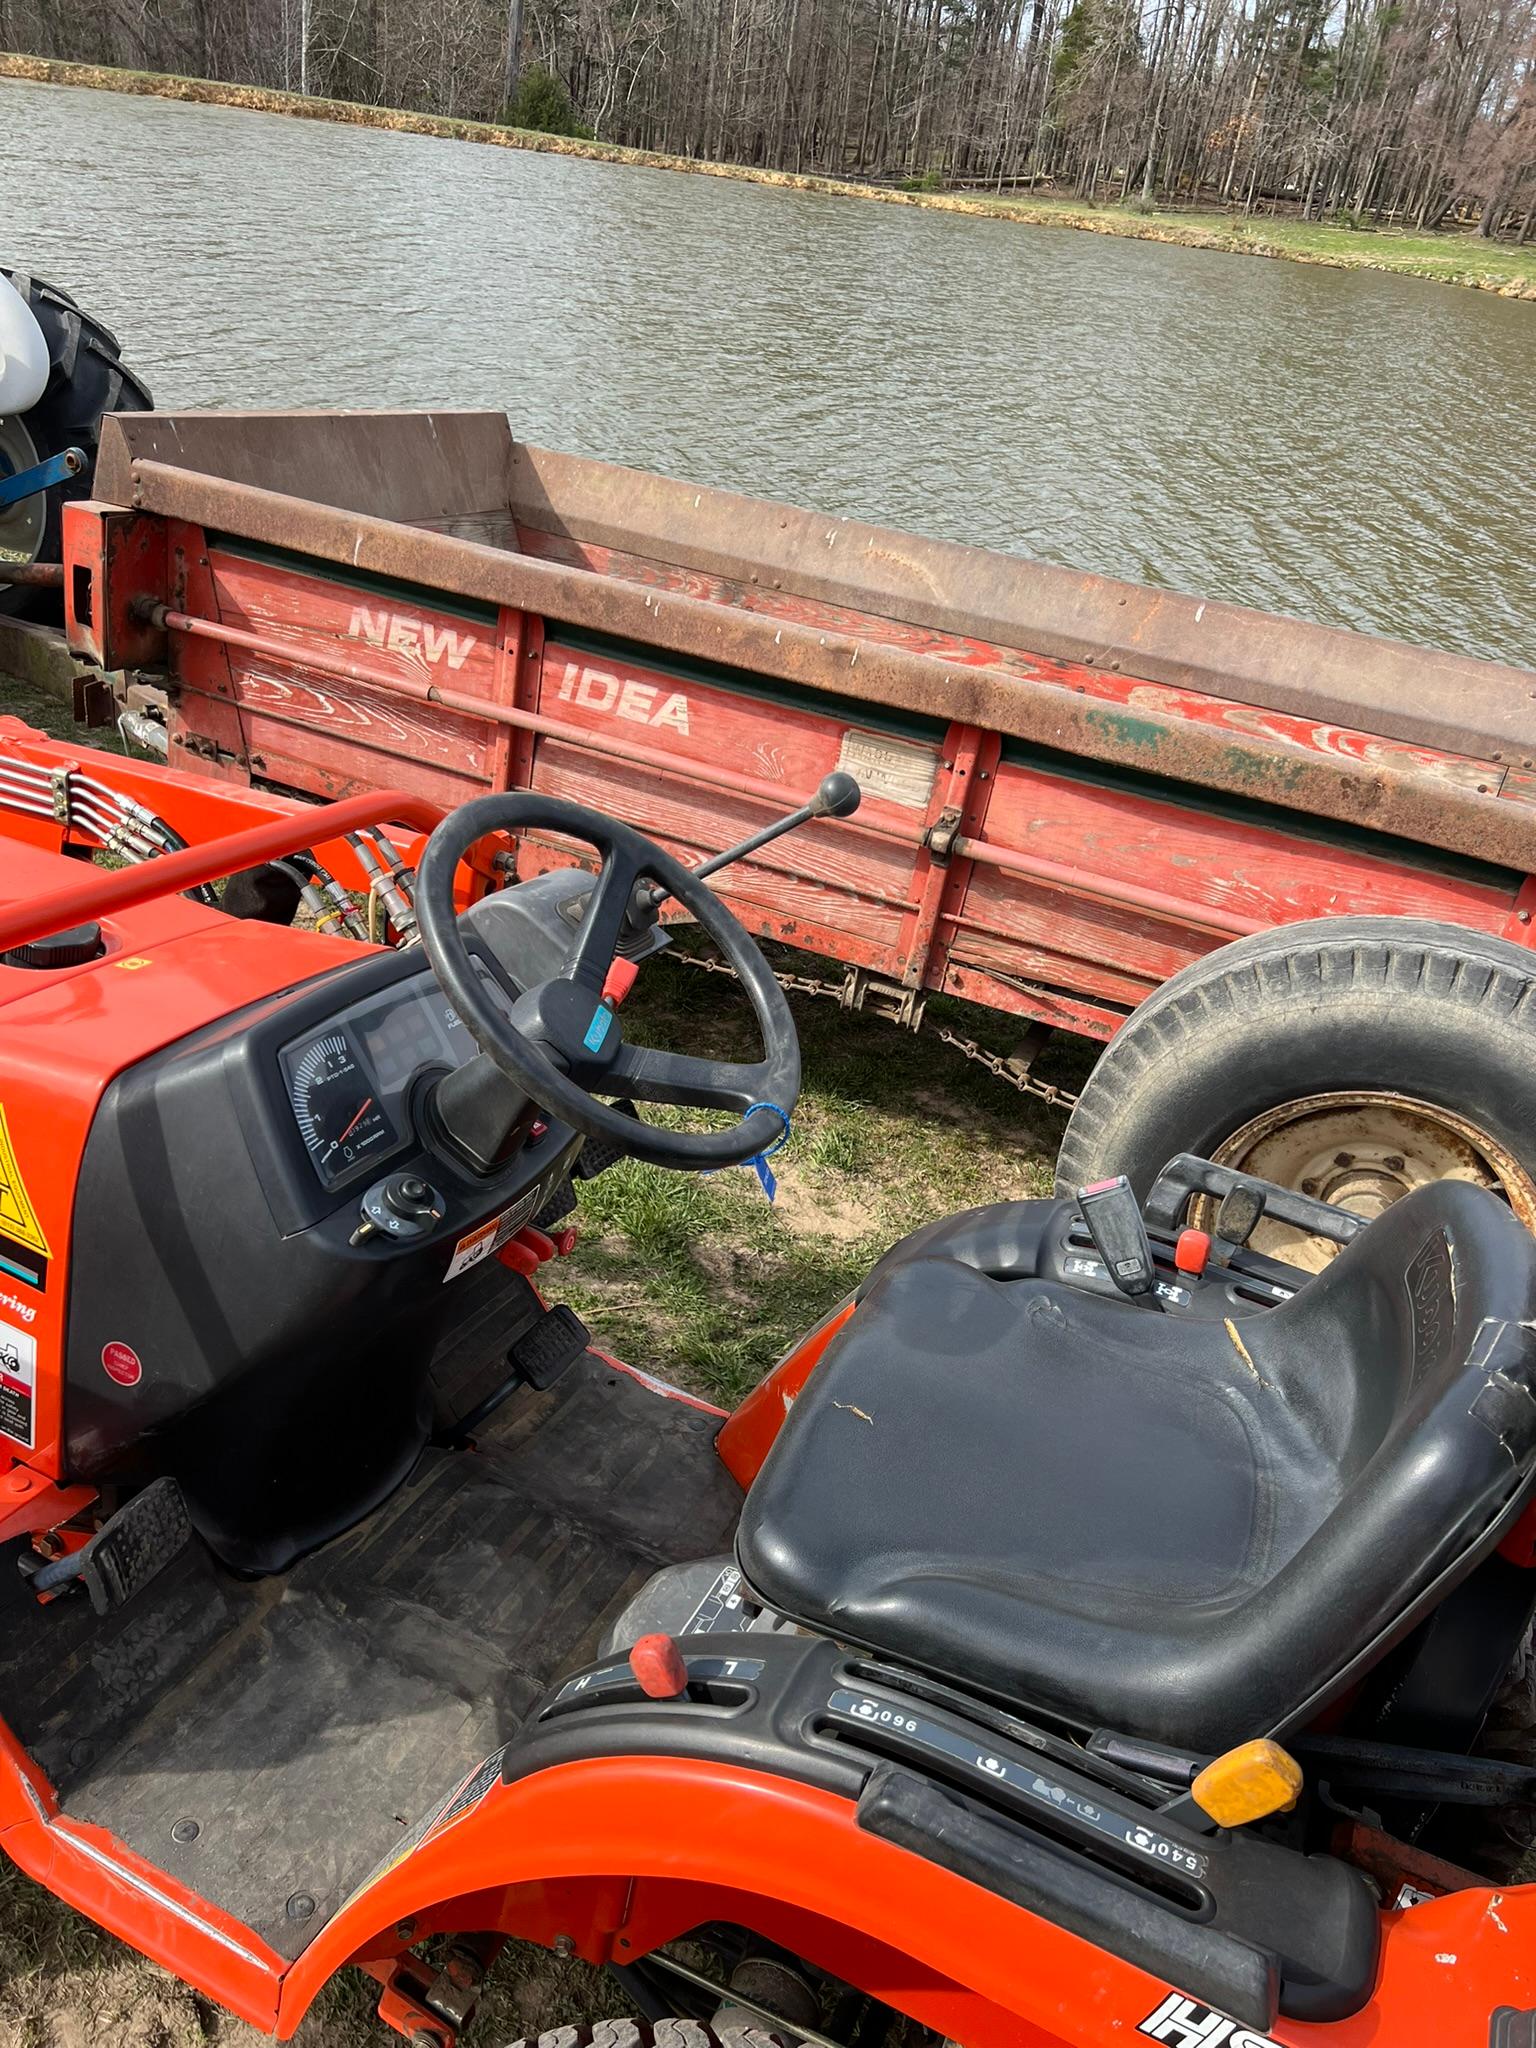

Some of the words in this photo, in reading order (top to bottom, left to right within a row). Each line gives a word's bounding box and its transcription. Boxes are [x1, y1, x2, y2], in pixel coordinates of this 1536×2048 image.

[348, 606, 477, 671] NEW
[558, 662, 690, 736] IDEA
[338, 1055, 347, 1064] 3
[315, 1076, 324, 1086] 2
[724, 1661, 739, 1675] L
[574, 1676, 592, 1691] H
[880, 1710, 917, 1733] 960
[1158, 1844, 1198, 1871] 540
